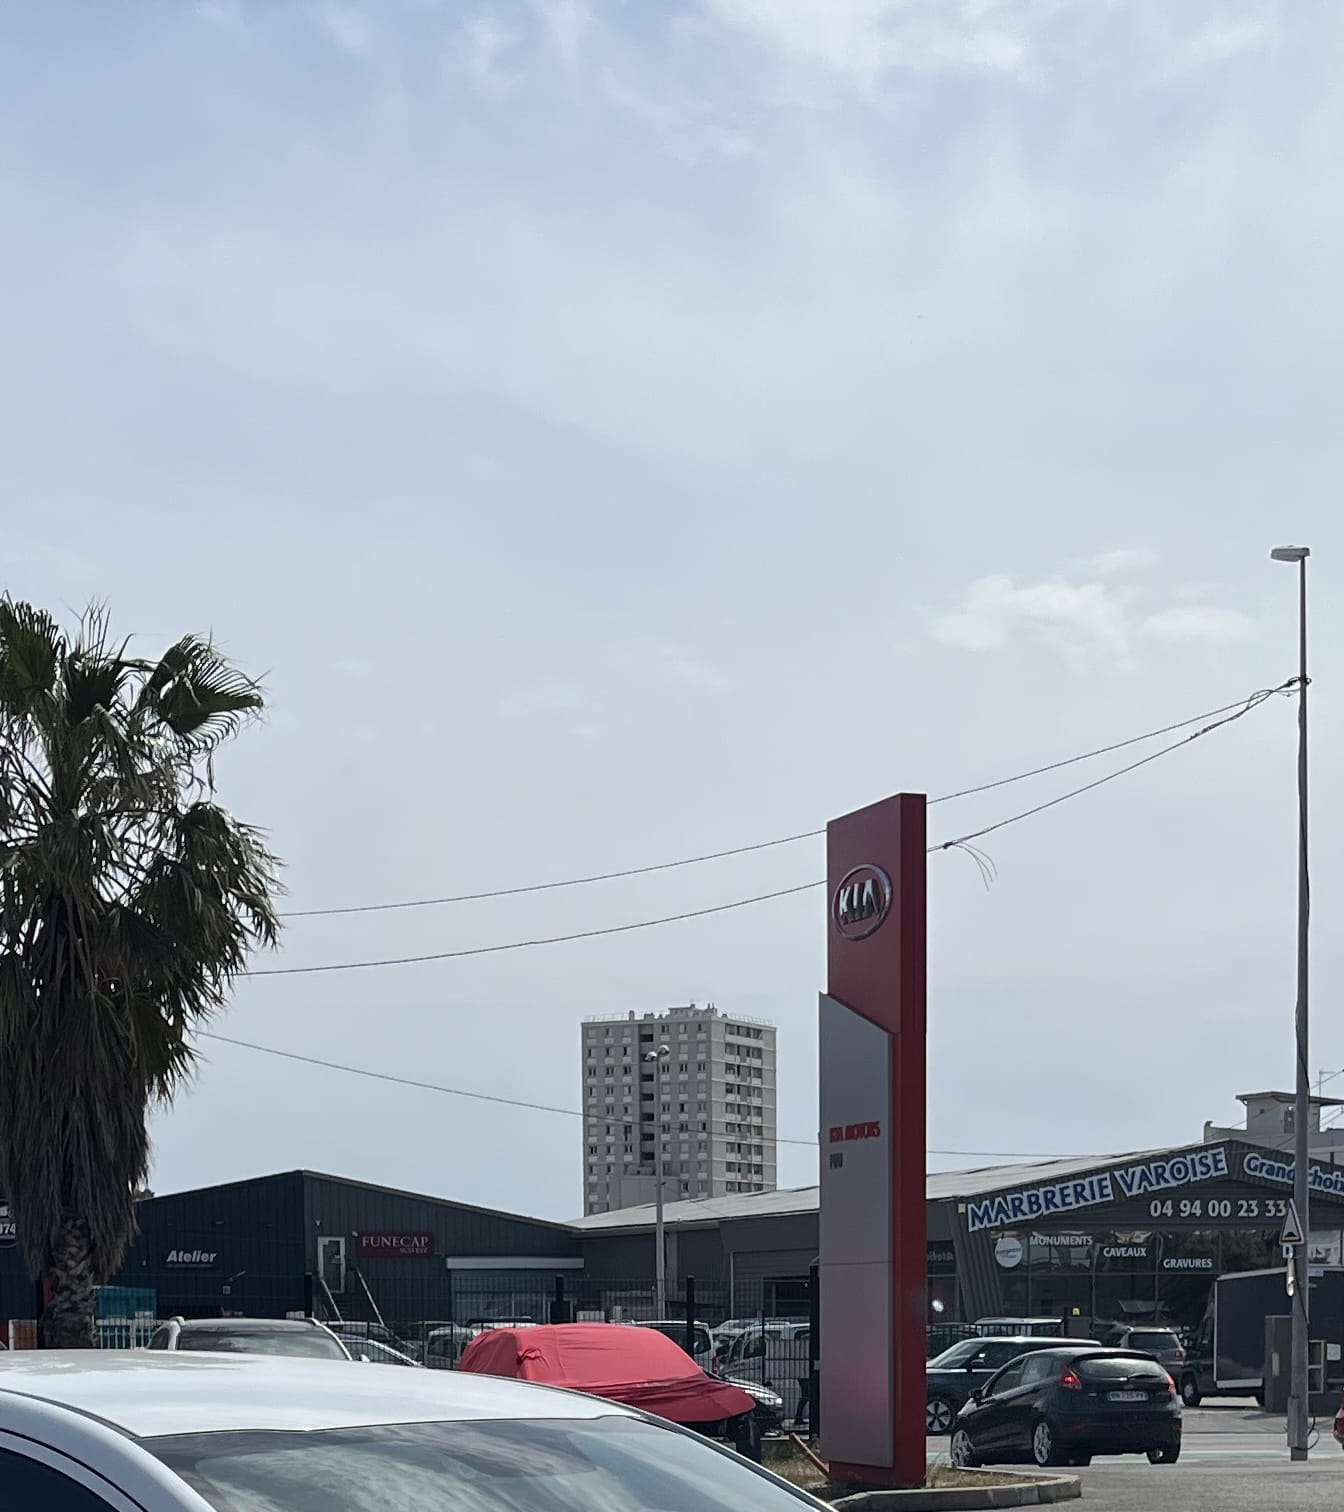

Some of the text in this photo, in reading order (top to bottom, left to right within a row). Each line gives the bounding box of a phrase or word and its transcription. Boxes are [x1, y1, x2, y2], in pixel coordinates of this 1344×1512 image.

[839, 879, 879, 918] KIA
[969, 1149, 1227, 1231] MARBRERIE VAROISE
[1150, 1200, 1287, 1217] 04 94 00 23 33
[362, 1236, 429, 1247] FUNECAP
[1030, 1236, 1093, 1246] MONUMENTS
[166, 1249, 217, 1262] Atelier
[1103, 1247, 1147, 1258] CAVEAUX
[1163, 1258, 1213, 1269] GRAVURES
